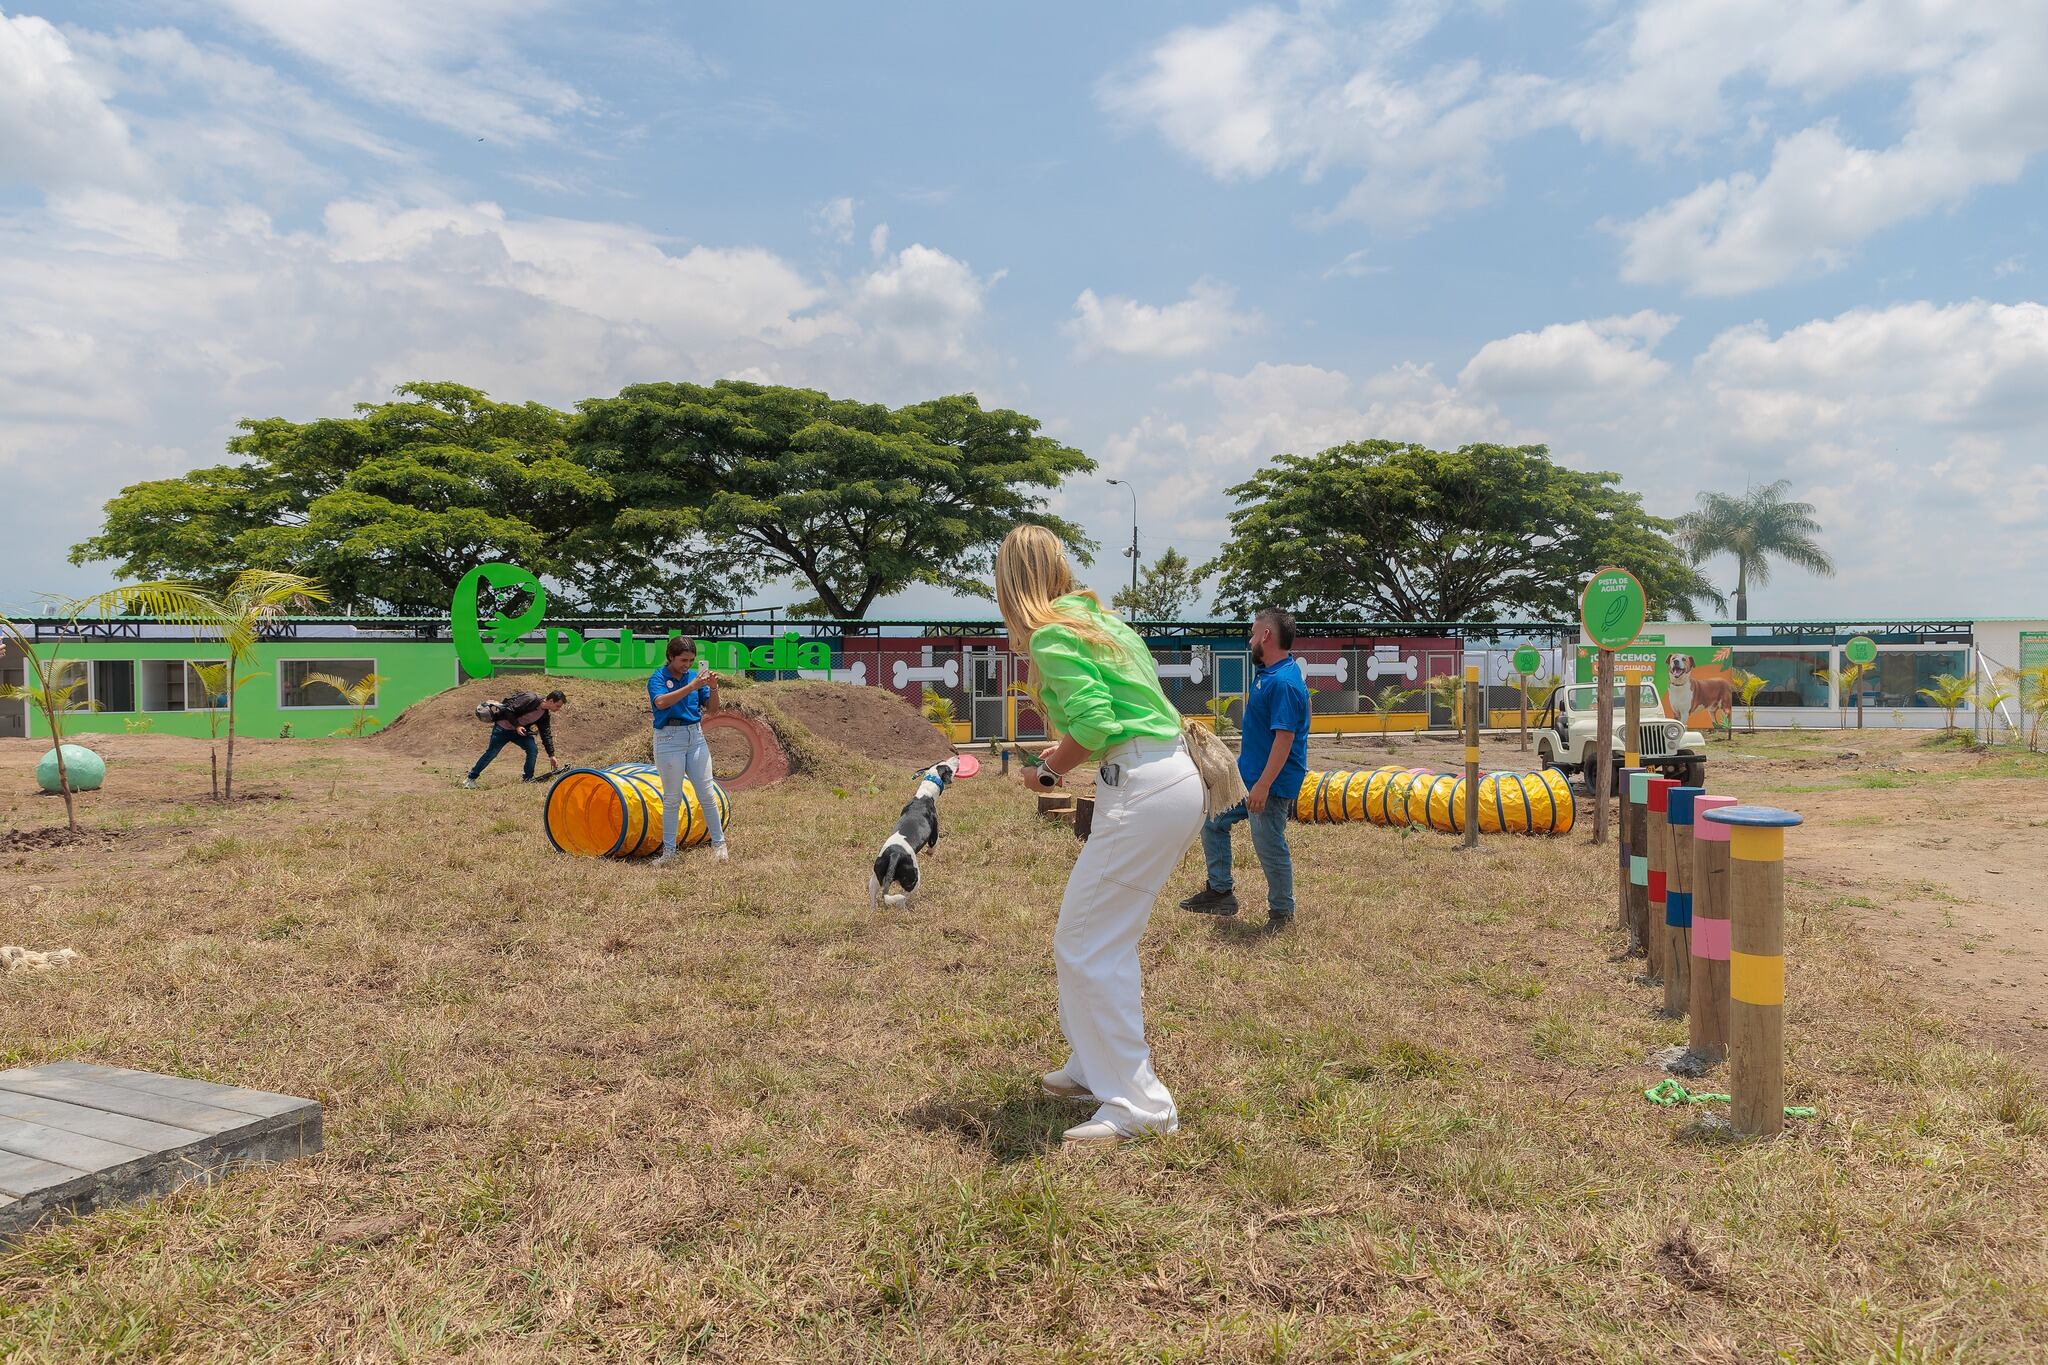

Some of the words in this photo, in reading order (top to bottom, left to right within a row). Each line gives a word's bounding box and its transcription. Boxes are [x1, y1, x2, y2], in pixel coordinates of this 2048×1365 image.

[1598, 578, 1617, 586] PISTA
[1601, 584, 1627, 592] AGILITY
[546, 627, 831, 669] Peluandia
[1590, 653, 1657, 663] ¡OECEMOS
